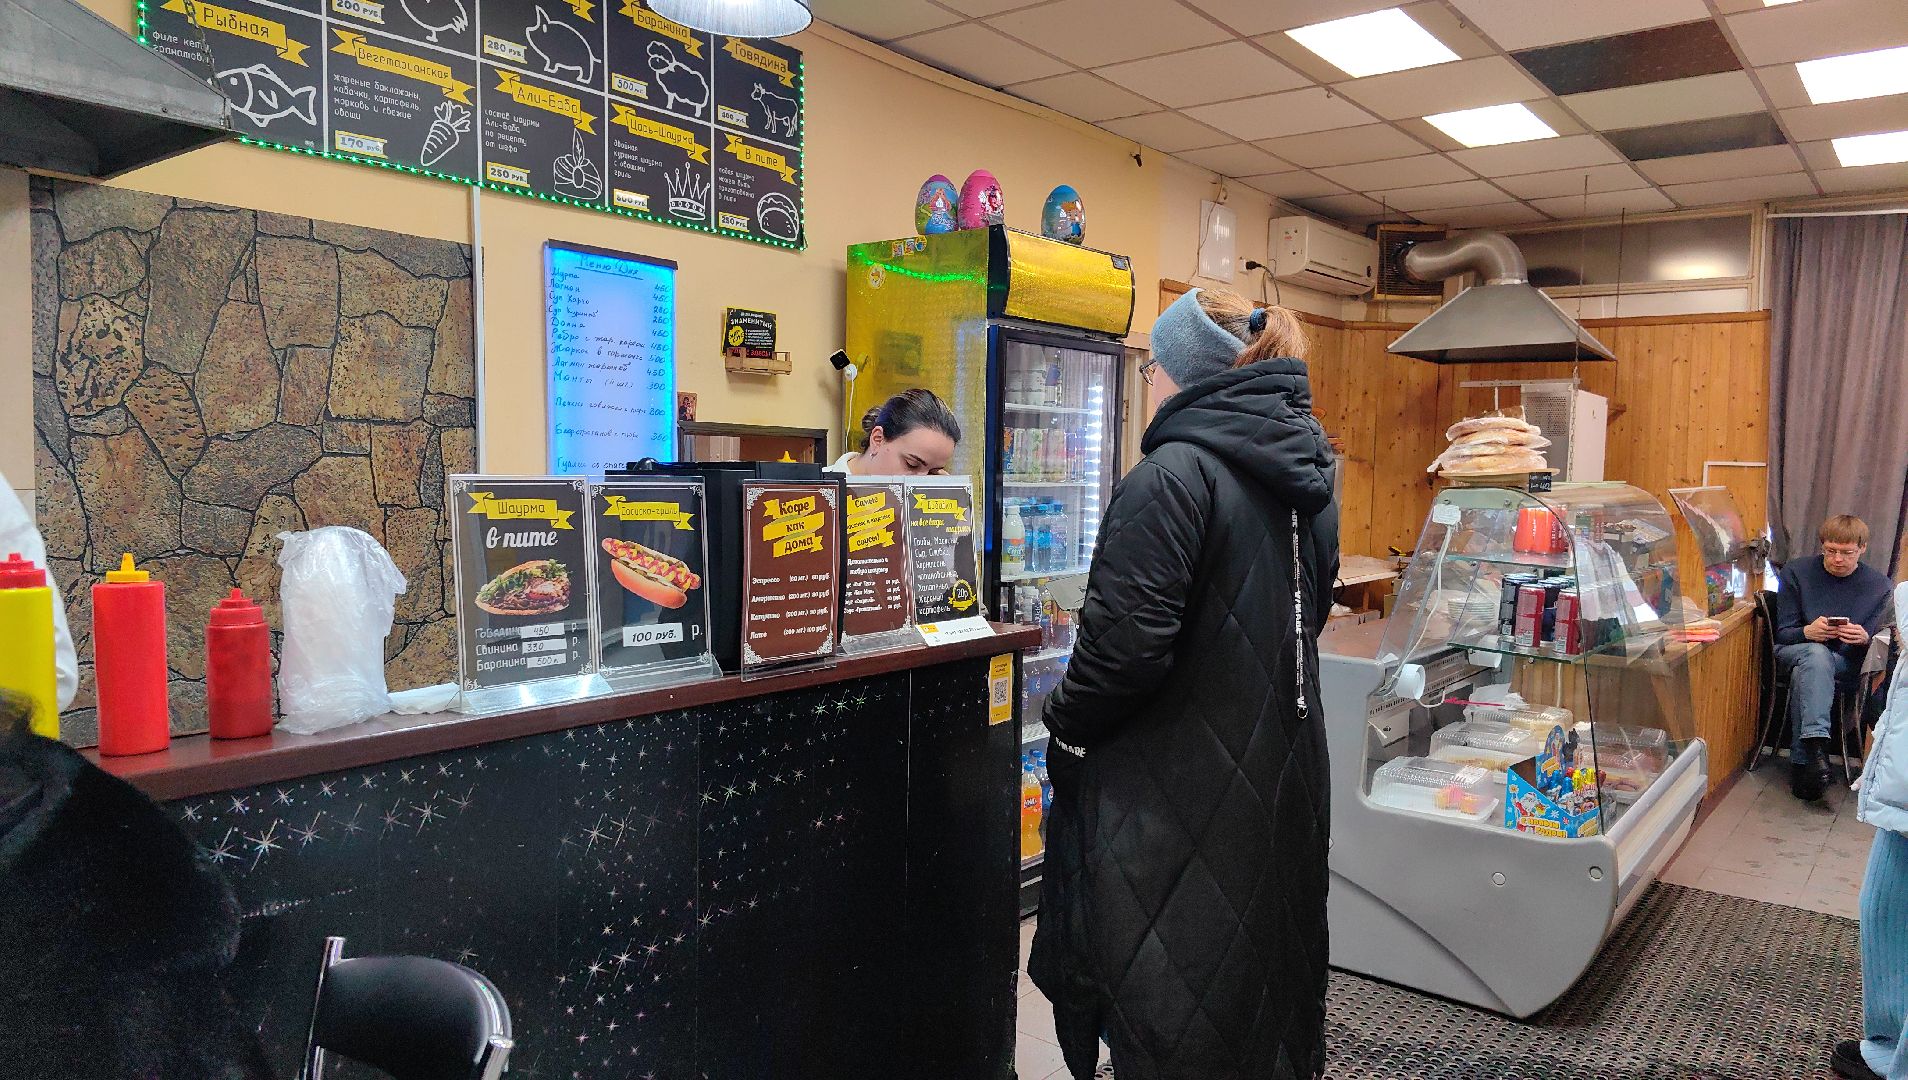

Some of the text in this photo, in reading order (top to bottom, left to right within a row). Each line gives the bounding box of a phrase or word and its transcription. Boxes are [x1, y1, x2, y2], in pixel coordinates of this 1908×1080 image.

[203, 7, 269, 38] Рыбная
[638, 9, 687, 38] Баранина
[152, 31, 178, 44] филе
[487, 40, 506, 53] 280
[358, 48, 449, 79] Вегетарианская
[735, 43, 787, 73] Говядина
[333, 74, 421, 101] жареные баклажаны,
[333, 85, 371, 101] кабачки,
[518, 87, 578, 113] Али-Баба
[334, 97, 370, 111] морковь
[382, 108, 412, 120] свежие
[334, 108, 361, 120] овощи
[485, 109, 540, 128] состав шаурмы
[485, 118, 521, 134] Али-Баба
[485, 130, 527, 146] по рецепту
[630, 119, 693, 145] Царь-Шаурма
[340, 137, 363, 149] 170
[498, 144, 518, 153] шефа
[614, 139, 638, 152] двойная
[614, 151, 663, 168] куриная шаурма
[745, 148, 778, 167] В пите
[490, 167, 510, 179] 250
[619, 160, 646, 173] овощами
[614, 170, 632, 180] гриль
[721, 215, 735, 225] 250
[580, 254, 638, 275] Меню Дня
[551, 267, 580, 283] Шурпа
[549, 291, 562, 304] Суп
[549, 305, 561, 316] Суп
[497, 502, 545, 517] Шаурма
[621, 506, 678, 517] Сосиска-гриль
[780, 501, 810, 515] Кофе
[786, 521, 805, 533] как
[486, 526, 559, 549] в пите
[752, 577, 781, 586] Эспрессо
[751, 594, 785, 603] Американо
[750, 613, 781, 622] Капучино
[571, 622, 580, 633] р.
[632, 624, 703, 643] 100 руб. р.
[750, 631, 768, 640] Латте
[475, 643, 518, 656] Свинина
[572, 636, 581, 647] р.
[476, 657, 527, 673] Баранина
[572, 651, 581, 661] р.
